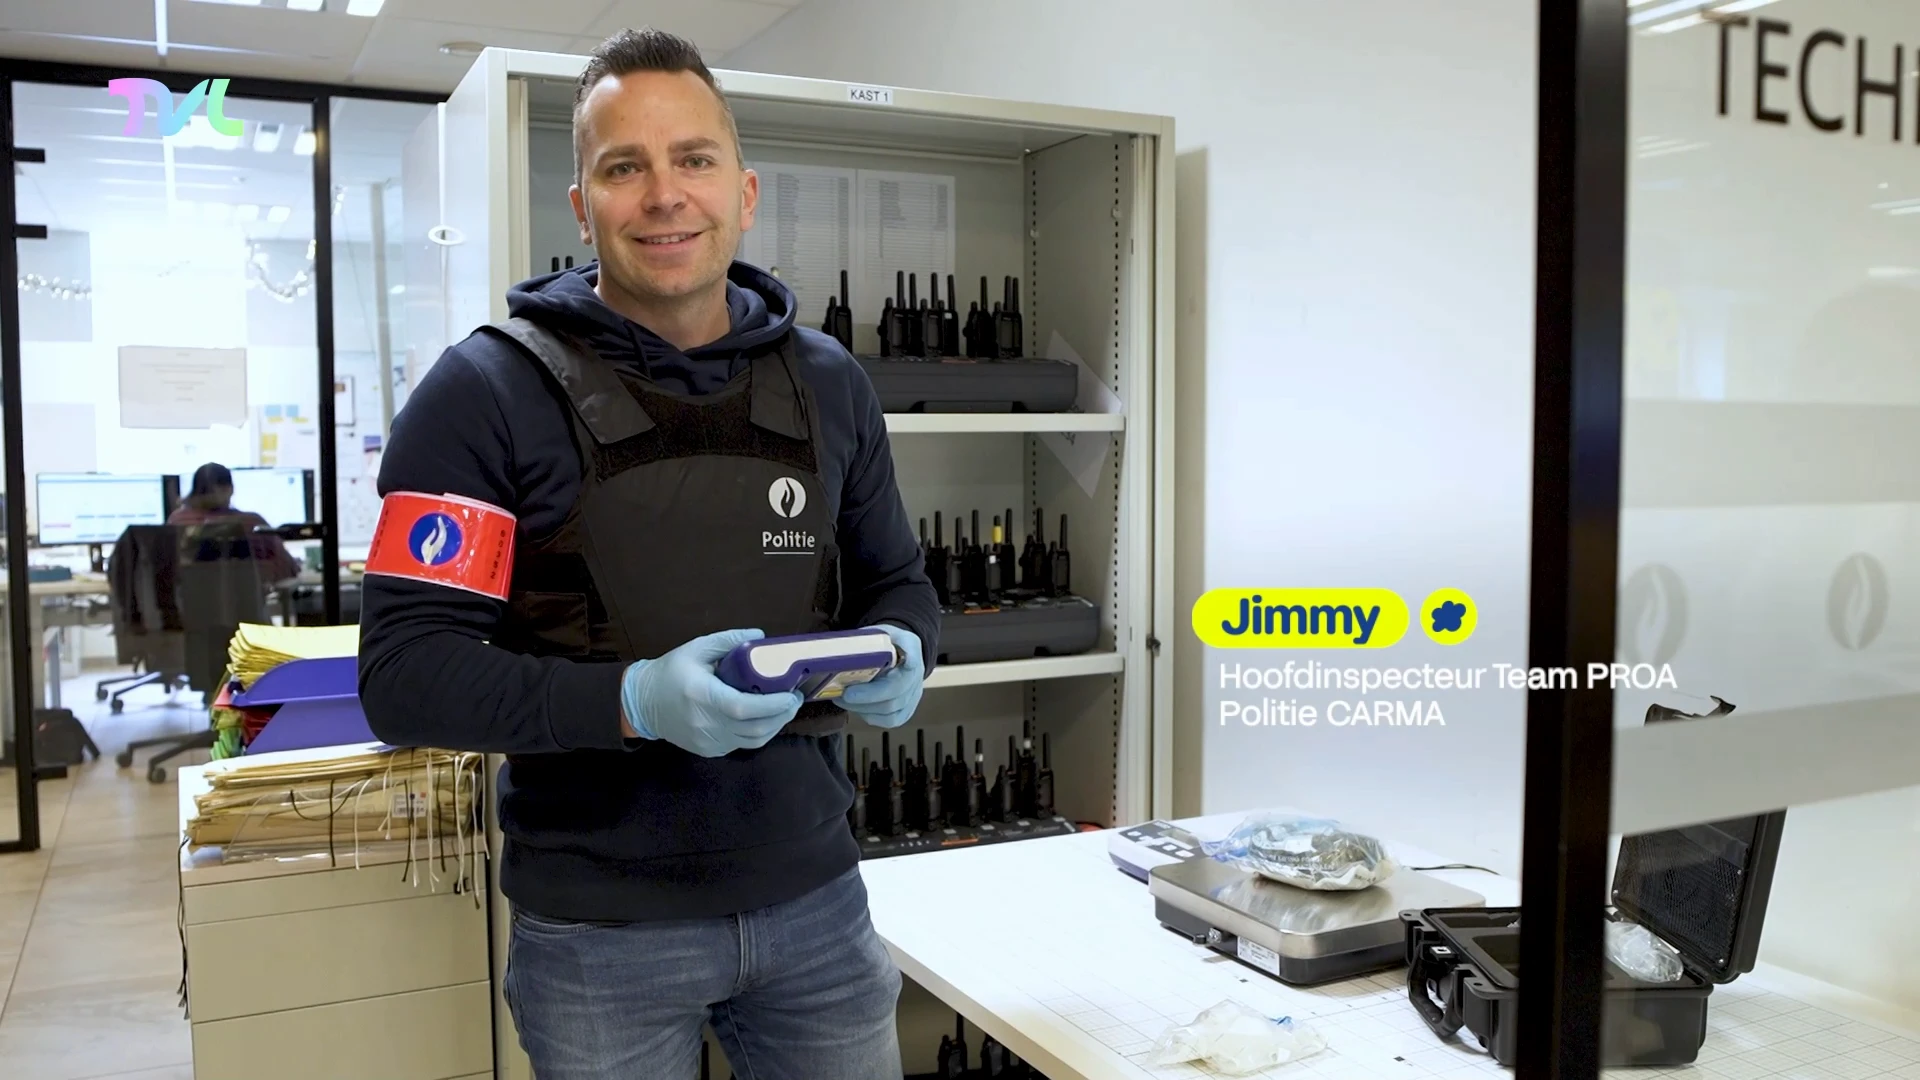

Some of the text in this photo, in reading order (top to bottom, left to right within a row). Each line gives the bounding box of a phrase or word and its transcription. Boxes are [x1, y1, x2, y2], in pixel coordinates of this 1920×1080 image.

[1700, 9, 1920, 146] TECH
[850, 89, 889, 102] KAST 1
[762, 530, 816, 548] Politie
